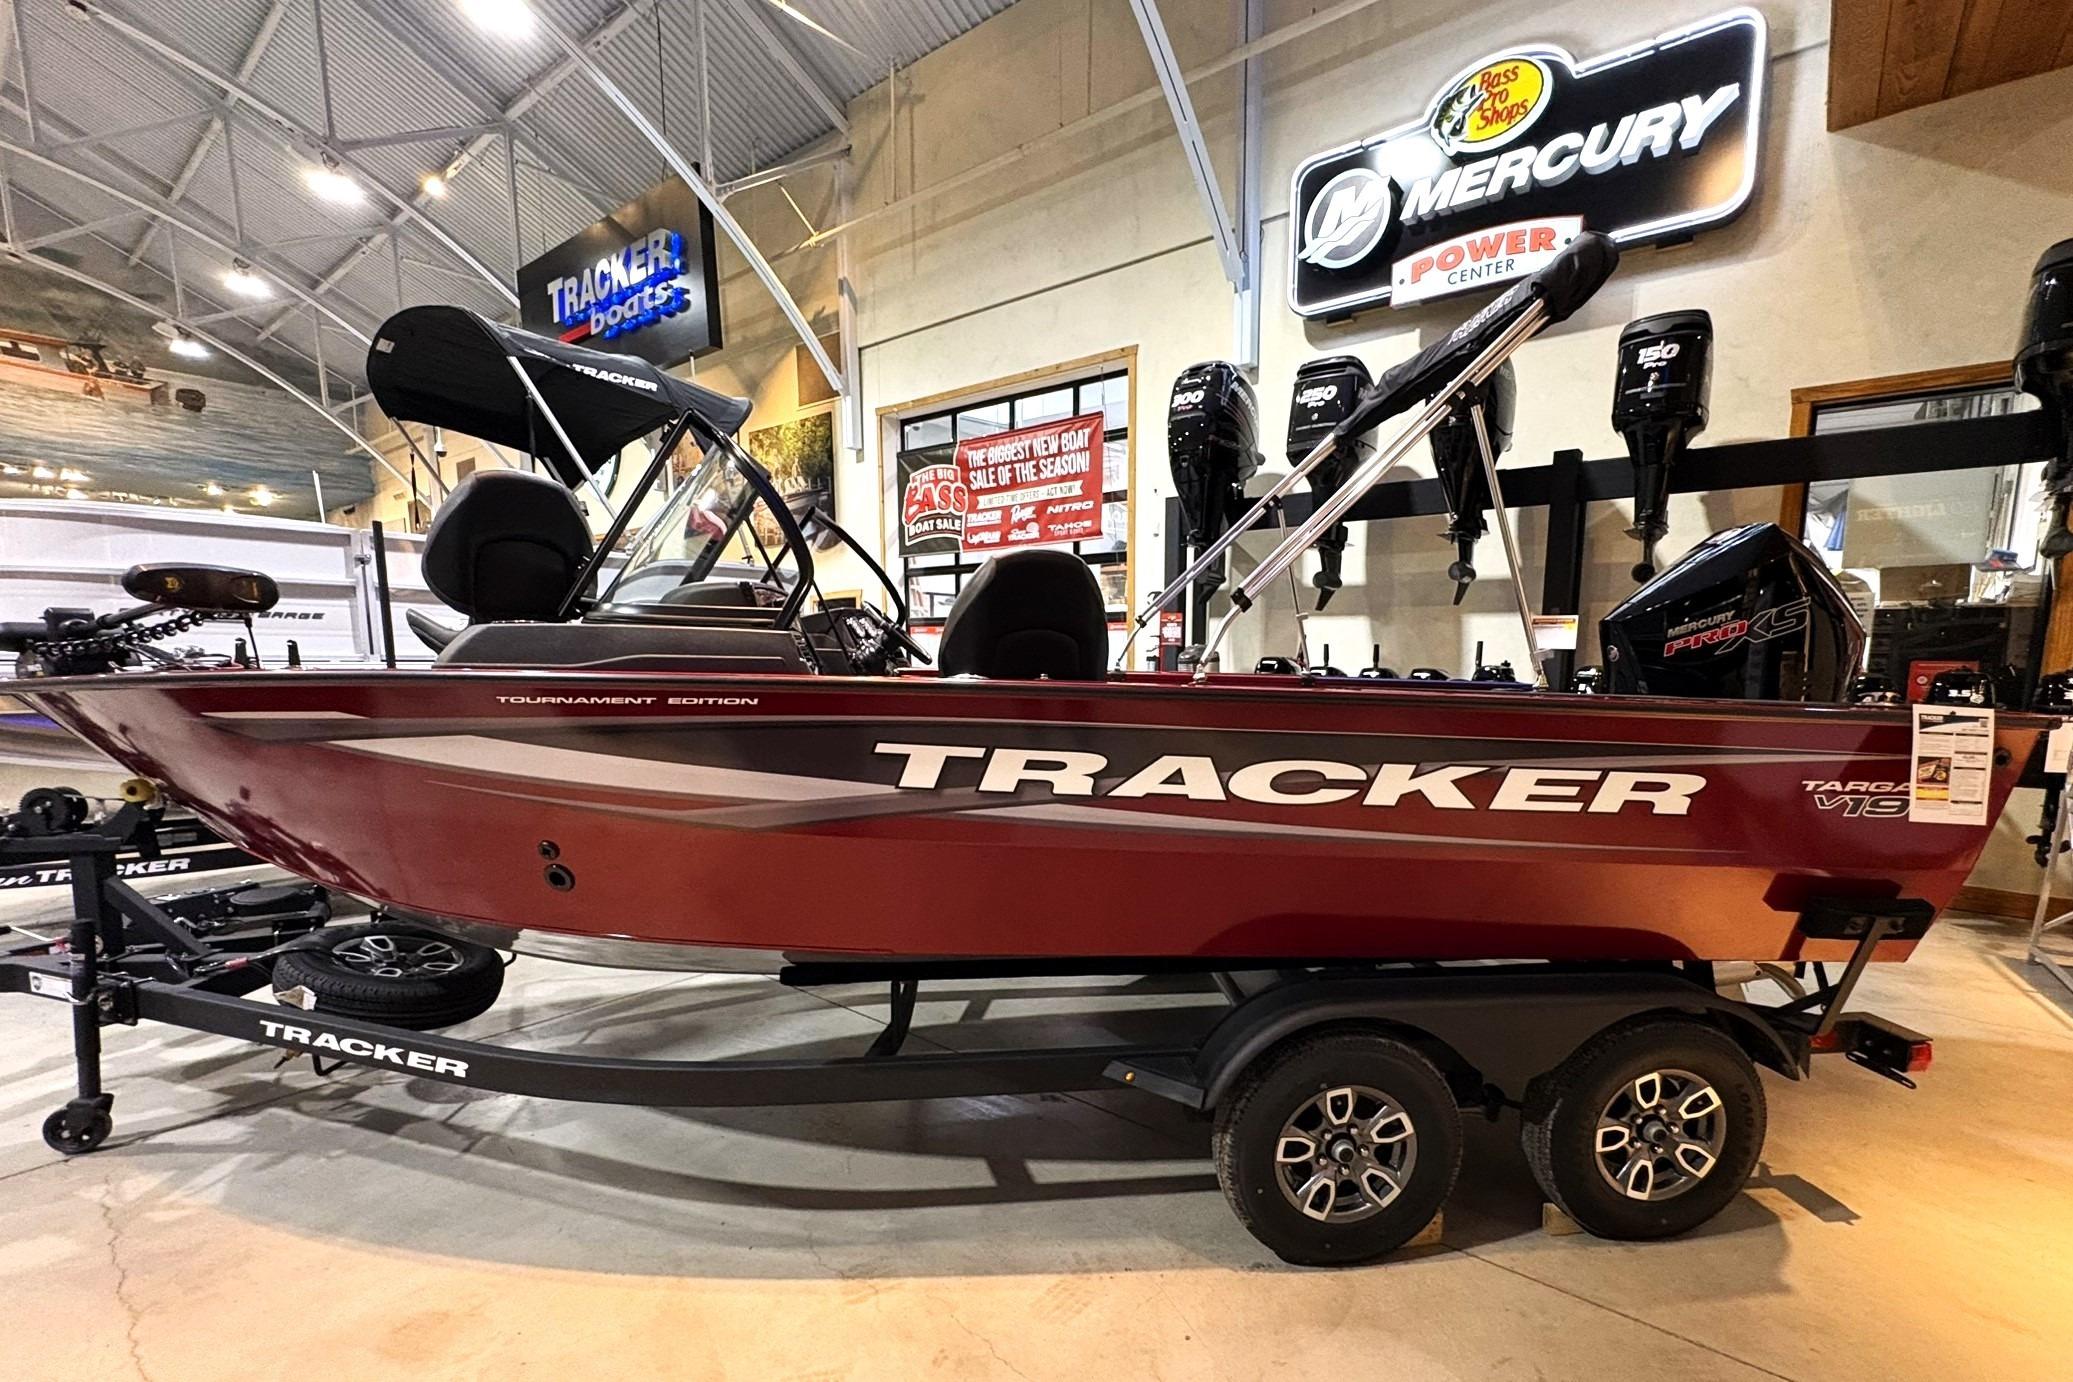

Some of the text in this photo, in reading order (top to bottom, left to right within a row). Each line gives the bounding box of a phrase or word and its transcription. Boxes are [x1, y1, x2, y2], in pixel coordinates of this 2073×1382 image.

[1479, 64, 1520, 94] Bass
[1476, 86, 1511, 111] Pro
[1475, 97, 1530, 131] Shops
[1400, 83, 1741, 225] MERCURY
[1410, 226, 1557, 285] POWER
[547, 228, 674, 323] TRACKER
[1447, 257, 1515, 286] CENTER
[590, 281, 669, 336] boats
[1637, 343, 1681, 365] 150
[572, 363, 658, 392] TRACKER
[1300, 385, 1338, 404] 250
[967, 427, 1091, 469] THE BIGGEST NEW BOAT
[915, 468, 956, 484] THE BIG
[969, 451, 1091, 491] SALE OF THE SEASON!
[1046, 500, 1095, 515] NITRO
[908, 518, 963, 538] BOAT SALE
[1047, 520, 1093, 532] TAHOE
[1667, 609, 1737, 639] MERCURY
[496, 696, 760, 706] TOURNAMENT EDITION
[874, 742, 1708, 815] TRACKER
[1801, 780, 1912, 793] TARGA
[36, 857, 192, 884] TRKER
[259, 1019, 470, 1079] TRACKER
